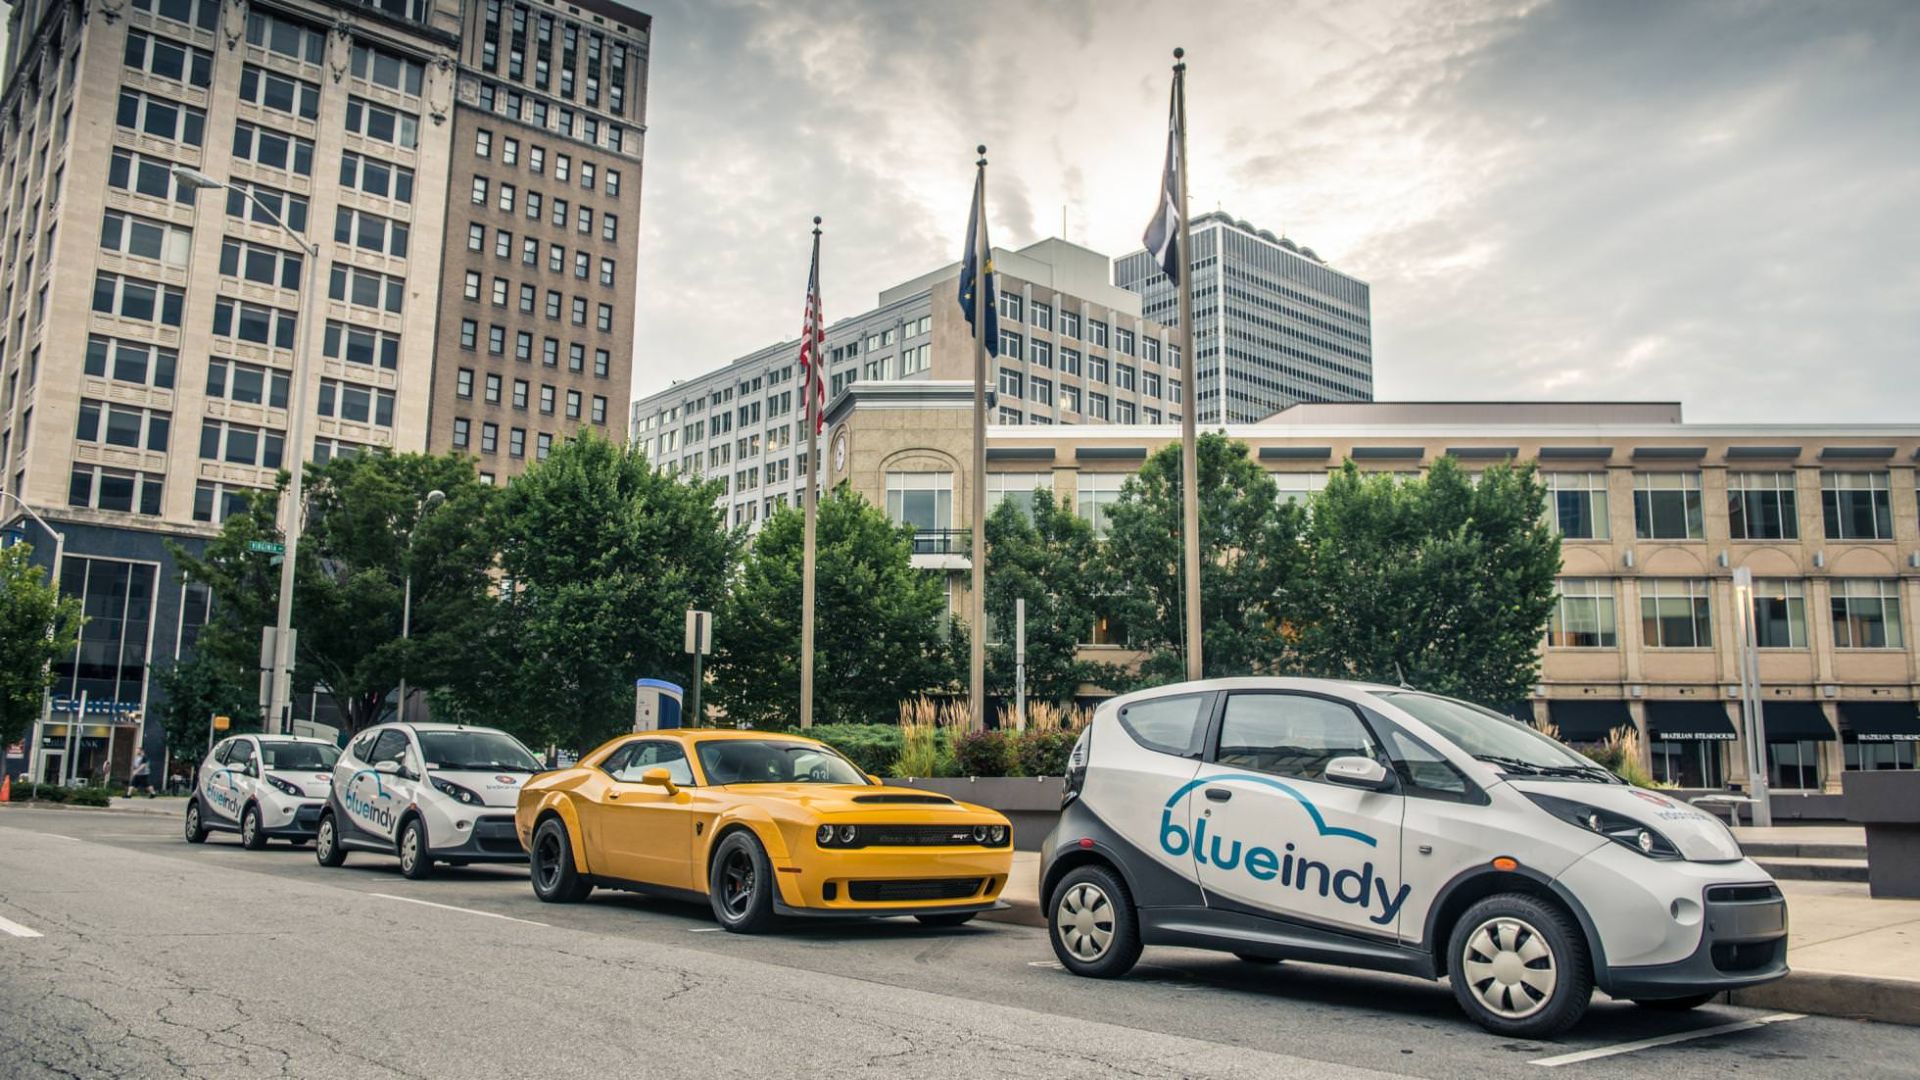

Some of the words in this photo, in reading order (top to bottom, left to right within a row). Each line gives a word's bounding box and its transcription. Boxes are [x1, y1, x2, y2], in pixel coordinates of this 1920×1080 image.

[207, 784, 241, 818] blueindy
[346, 789, 396, 835] blueindy
[1160, 808, 1411, 925] blueindy
